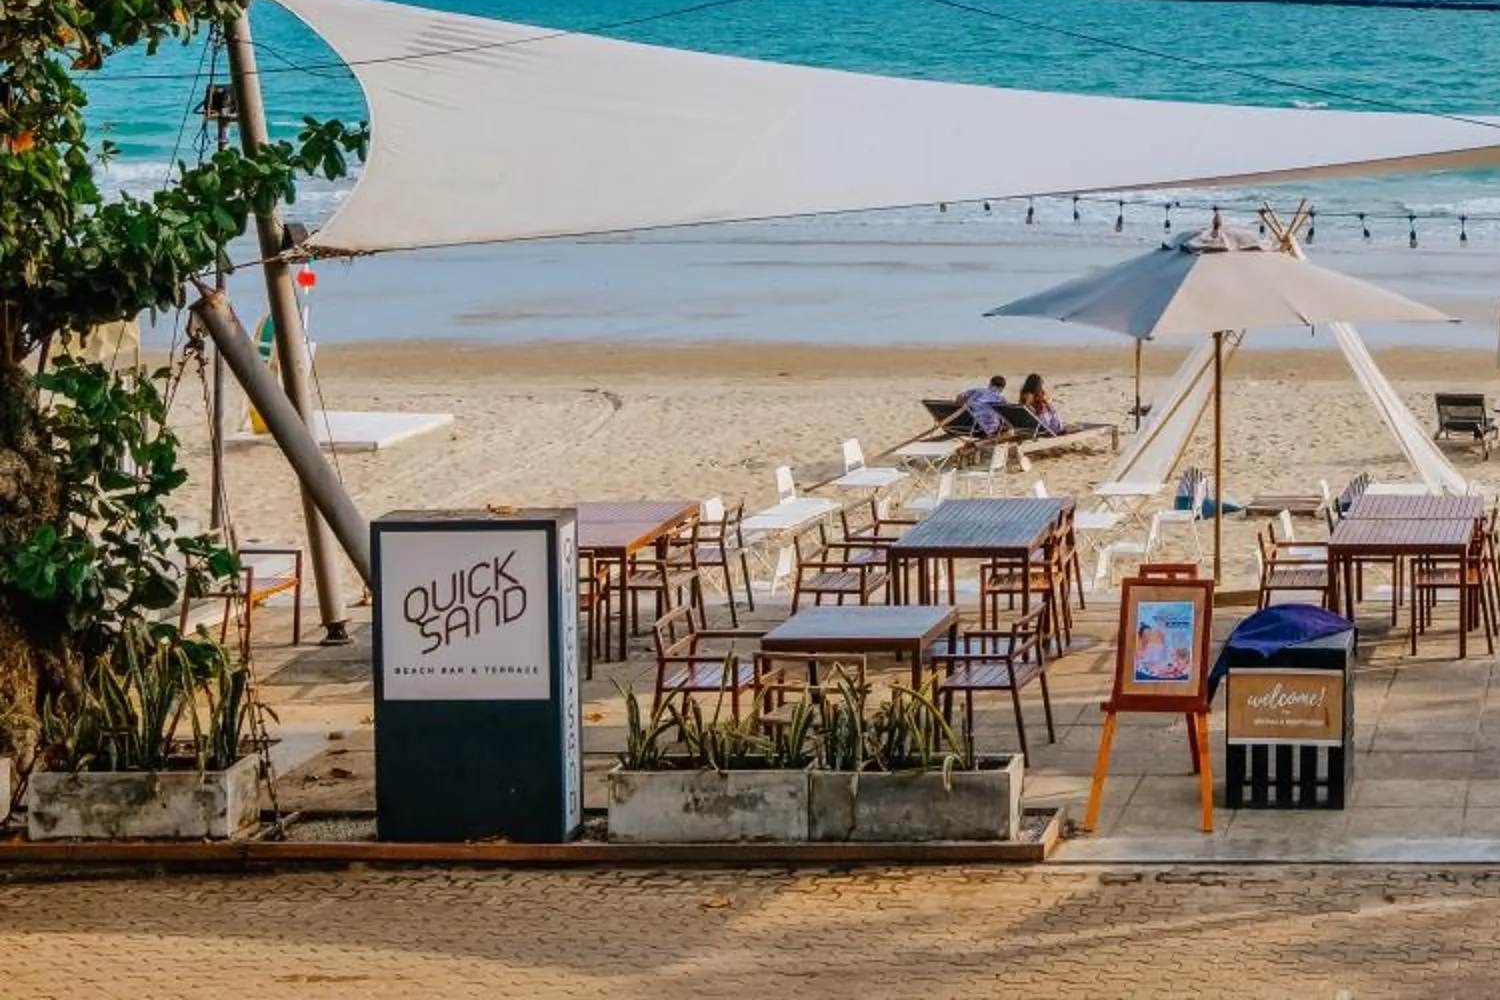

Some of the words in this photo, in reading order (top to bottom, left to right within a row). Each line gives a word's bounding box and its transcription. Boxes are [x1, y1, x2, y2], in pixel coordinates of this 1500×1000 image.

[403, 550, 519, 626] QUICK
[420, 585, 527, 654] SAND
[394, 666, 435, 675] BEACH
[441, 666, 465, 675] BAR
[484, 665, 539, 675] TERRACE
[1247, 682, 1327, 709] welcome!
